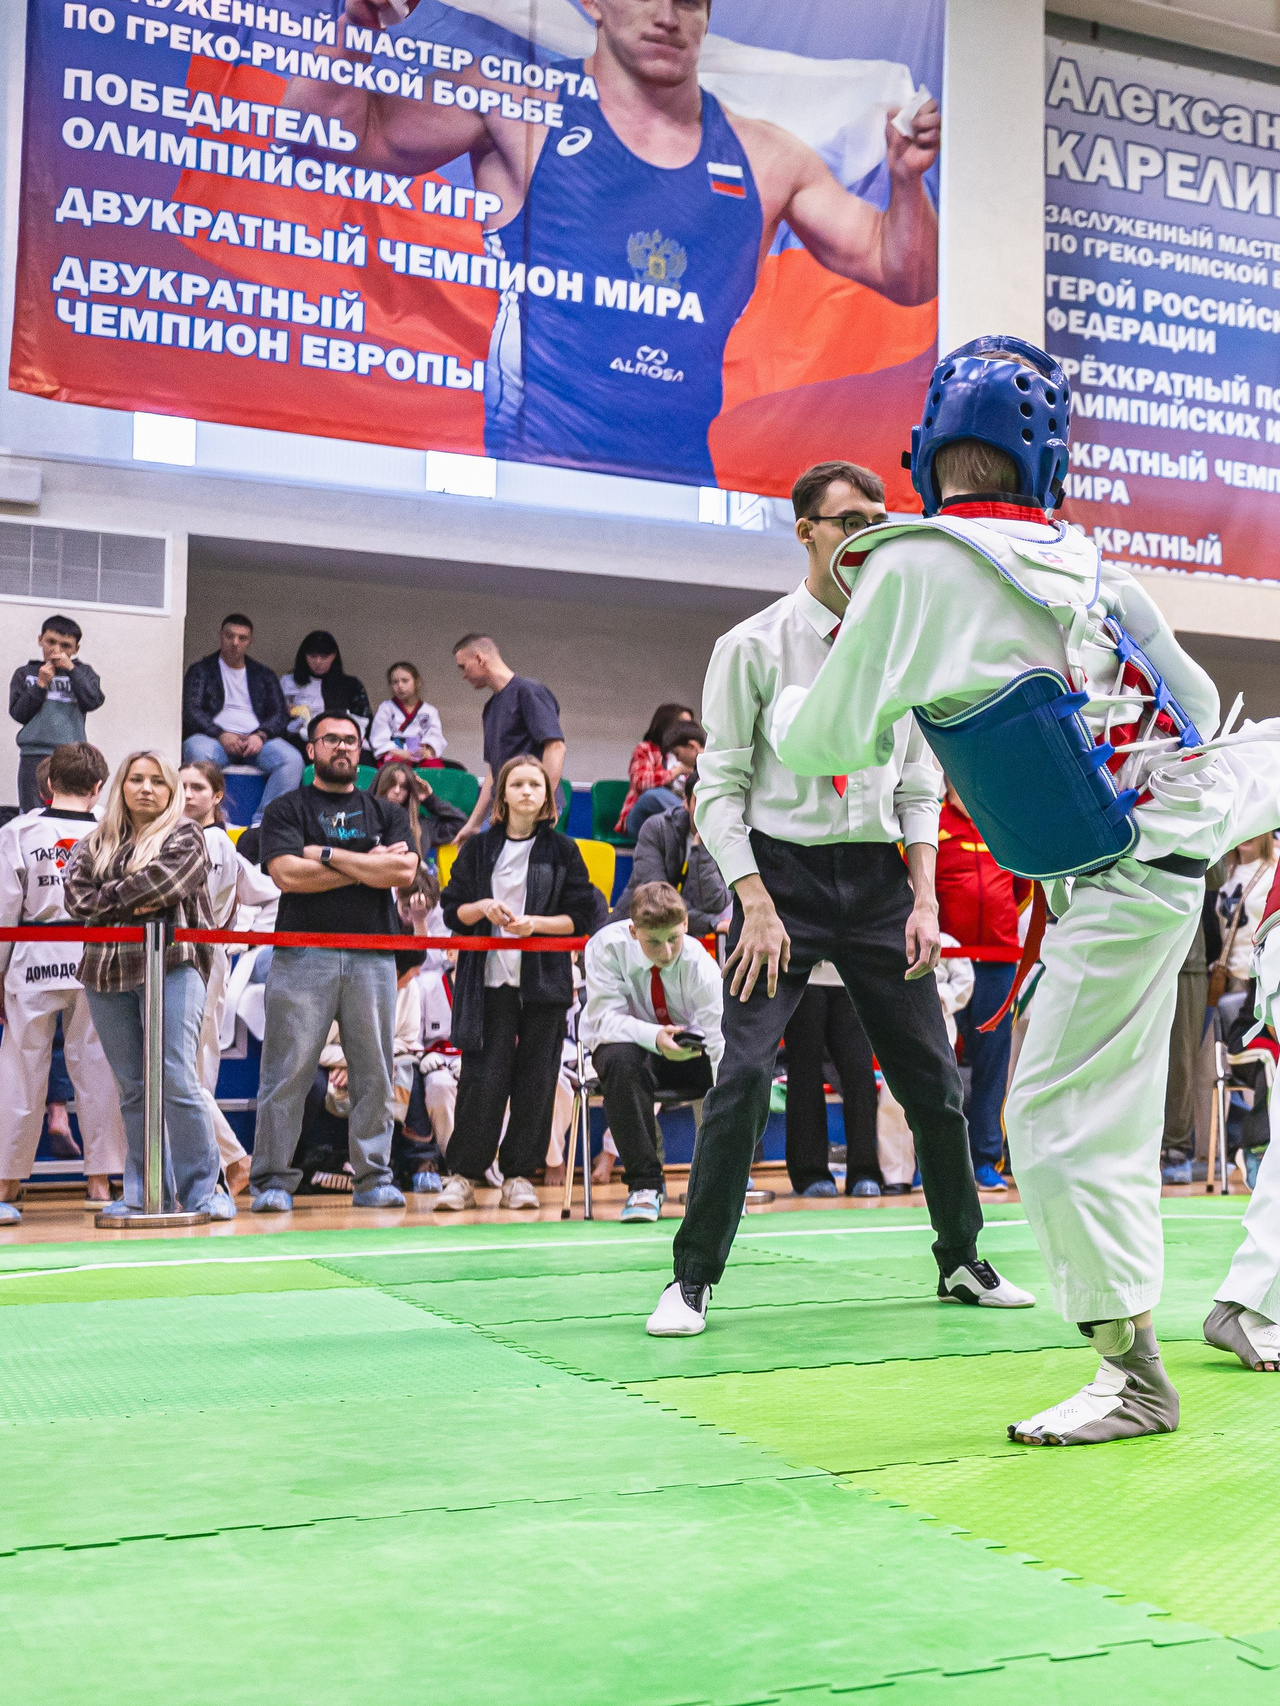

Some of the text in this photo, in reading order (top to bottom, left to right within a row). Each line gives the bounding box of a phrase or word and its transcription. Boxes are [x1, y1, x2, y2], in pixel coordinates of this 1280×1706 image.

[63, 3, 564, 128] ПО ГРЕКО-РИМСКОЙ БОРЬБЕ
[131, 0, 599, 100] ЖЕННЫЙ МАСТЕР СПОРТА
[62, 68, 359, 153] ПОБЕДИТЕЛЬ
[61, 116, 502, 222] ОЛИМПИЙСКИХ ИГР
[55, 186, 705, 323] ДВУКРАТНЫЙ ЧЕМПИОН МИРА
[1045, 205, 1214, 250] ЗАСЛУЖЕННЫЙ
[1045, 232, 1078, 254] ПО
[1083, 236, 1269, 286] ГРЕКО-РИМСКОЙ
[52, 256, 366, 333] ДВУКРАТНЫЙ
[1046, 274, 1136, 311] ГЕРОЙ
[1046, 306, 1217, 354] ФЕДЕРАЦИИ
[55, 298, 485, 392] ЧЕМПИОН ЕВРОПЫ
[610, 356, 685, 383] ALROSA
[1071, 391, 1261, 440] ЛИМПИЙСКИХ
